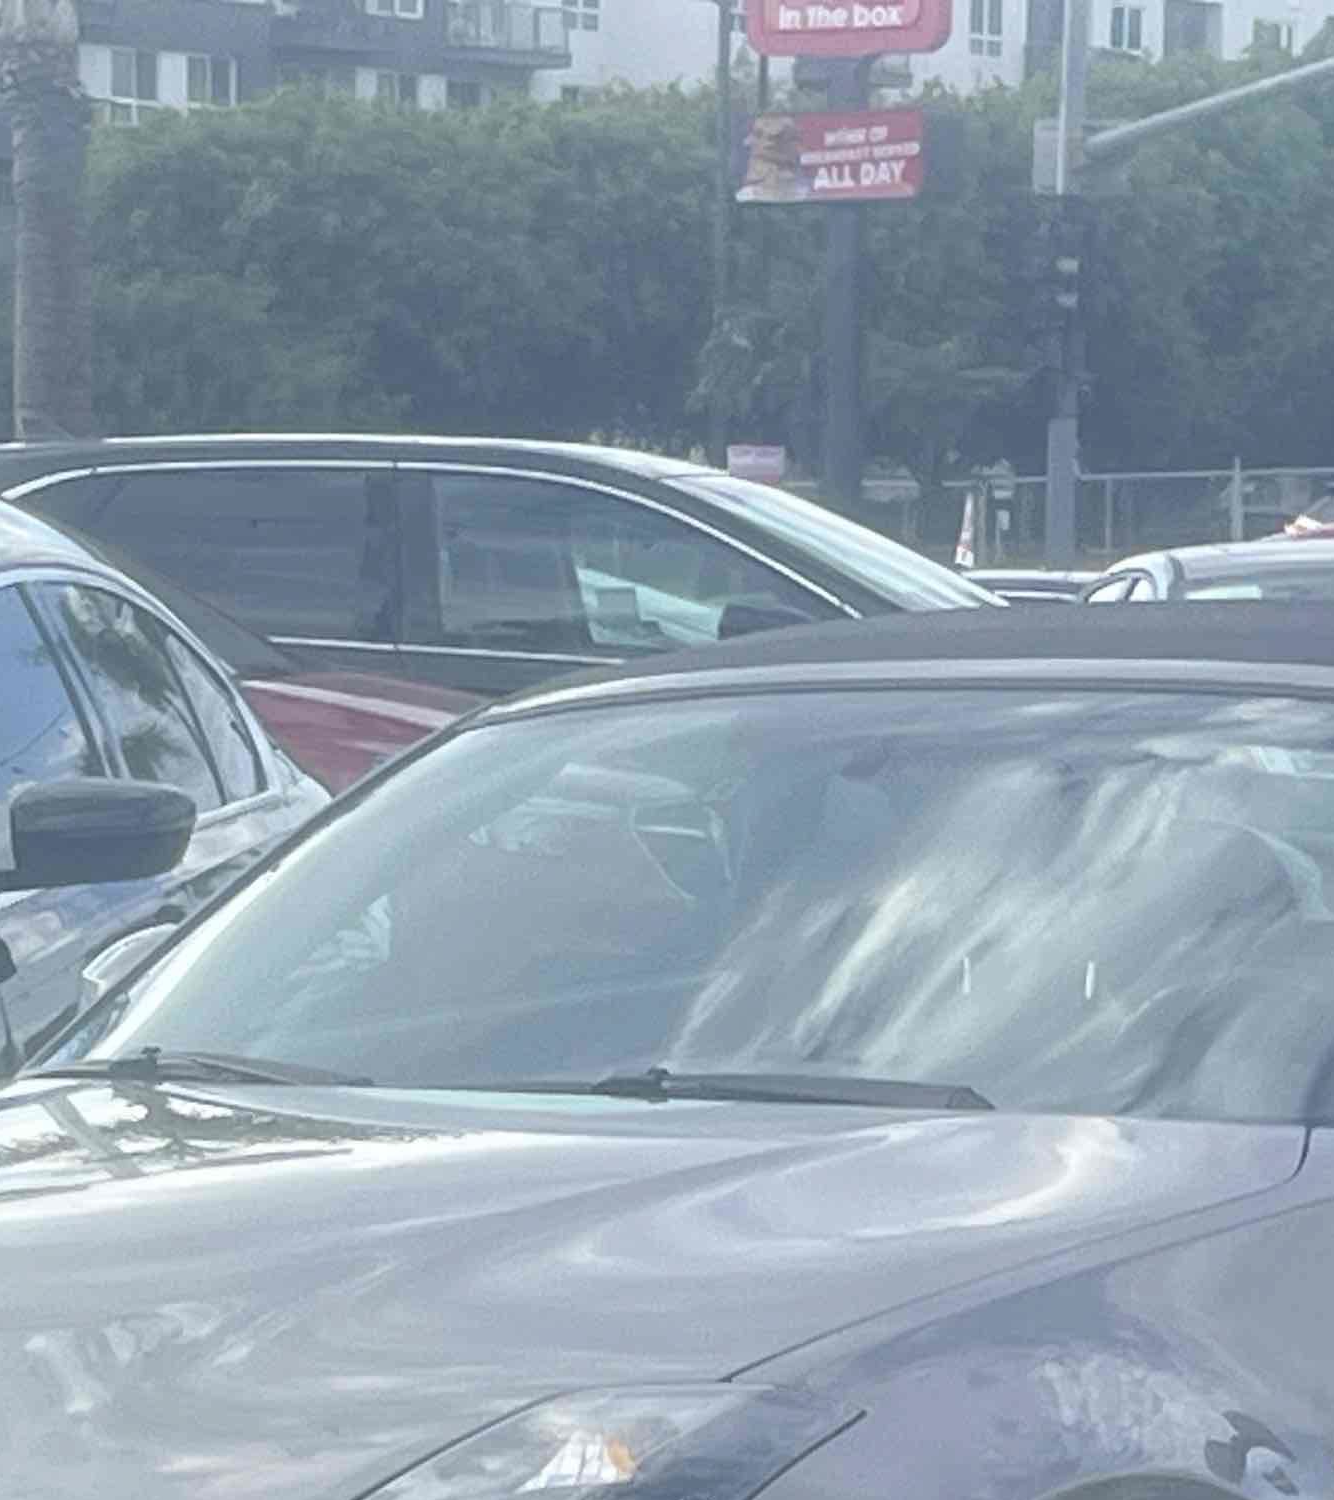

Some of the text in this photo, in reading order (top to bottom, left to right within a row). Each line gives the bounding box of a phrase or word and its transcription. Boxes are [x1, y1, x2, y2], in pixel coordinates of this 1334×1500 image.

[852, 3, 903, 27] box
[814, 158, 907, 190] ALL DAY
